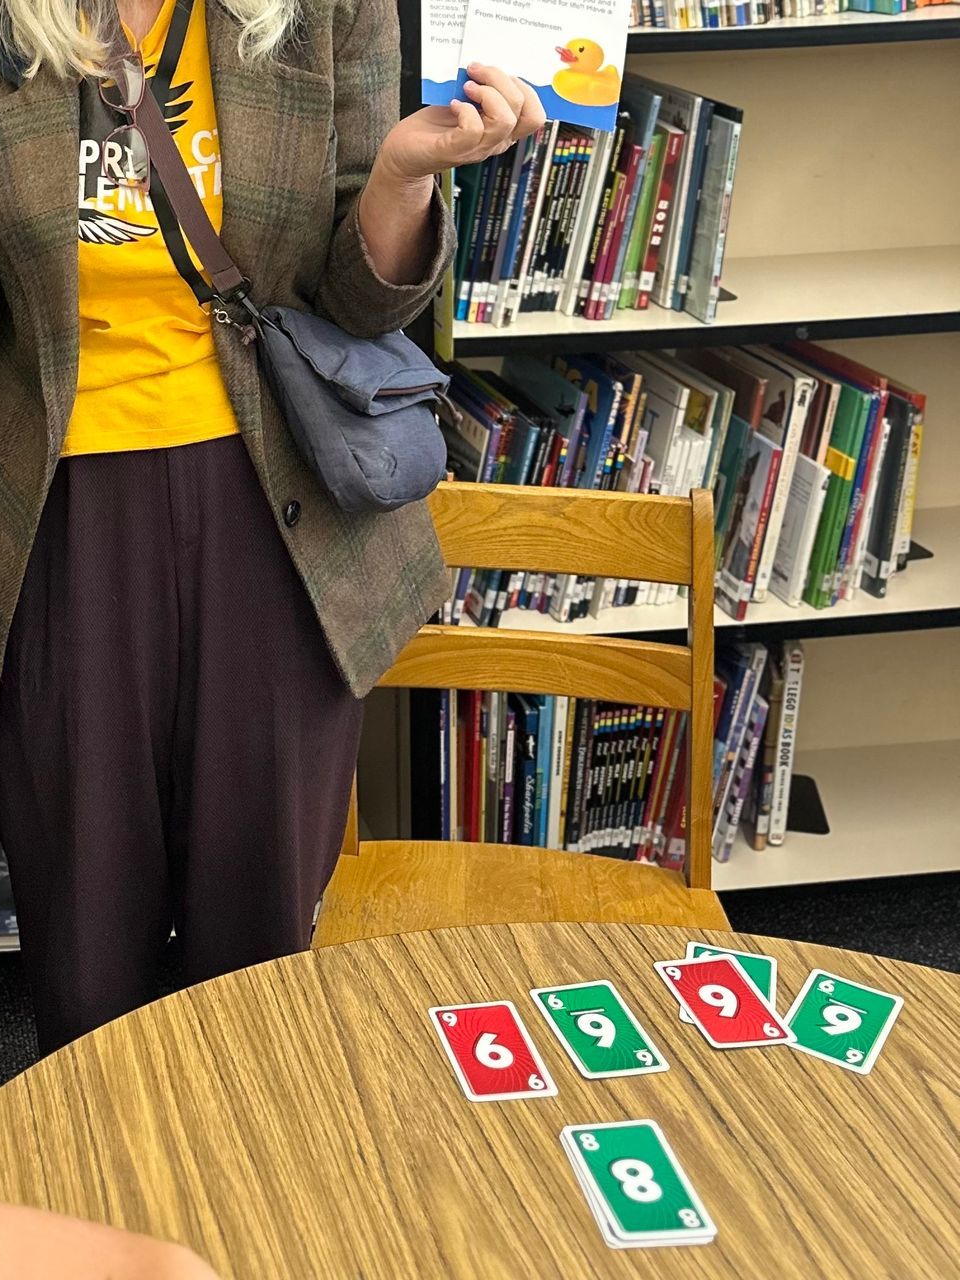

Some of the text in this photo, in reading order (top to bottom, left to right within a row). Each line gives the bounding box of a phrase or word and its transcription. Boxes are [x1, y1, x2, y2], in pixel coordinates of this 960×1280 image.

[475, 9, 494, 19] From
[590, 188, 611, 264] ELECTRIC MISCHIEF
[651, 200, 669, 245] BOMB
[786, 686, 797, 710] LEGO
[779, 740, 792, 767] BOOK
[522, 775, 536, 835] Sharkpedia
[666, 967, 681, 981] 9
[698, 984, 737, 1018] 9
[442, 1013, 457, 1027] 9
[579, 1133, 600, 1151] 8
[611, 1159, 663, 1202] 8
[678, 1209, 700, 1227] 8
